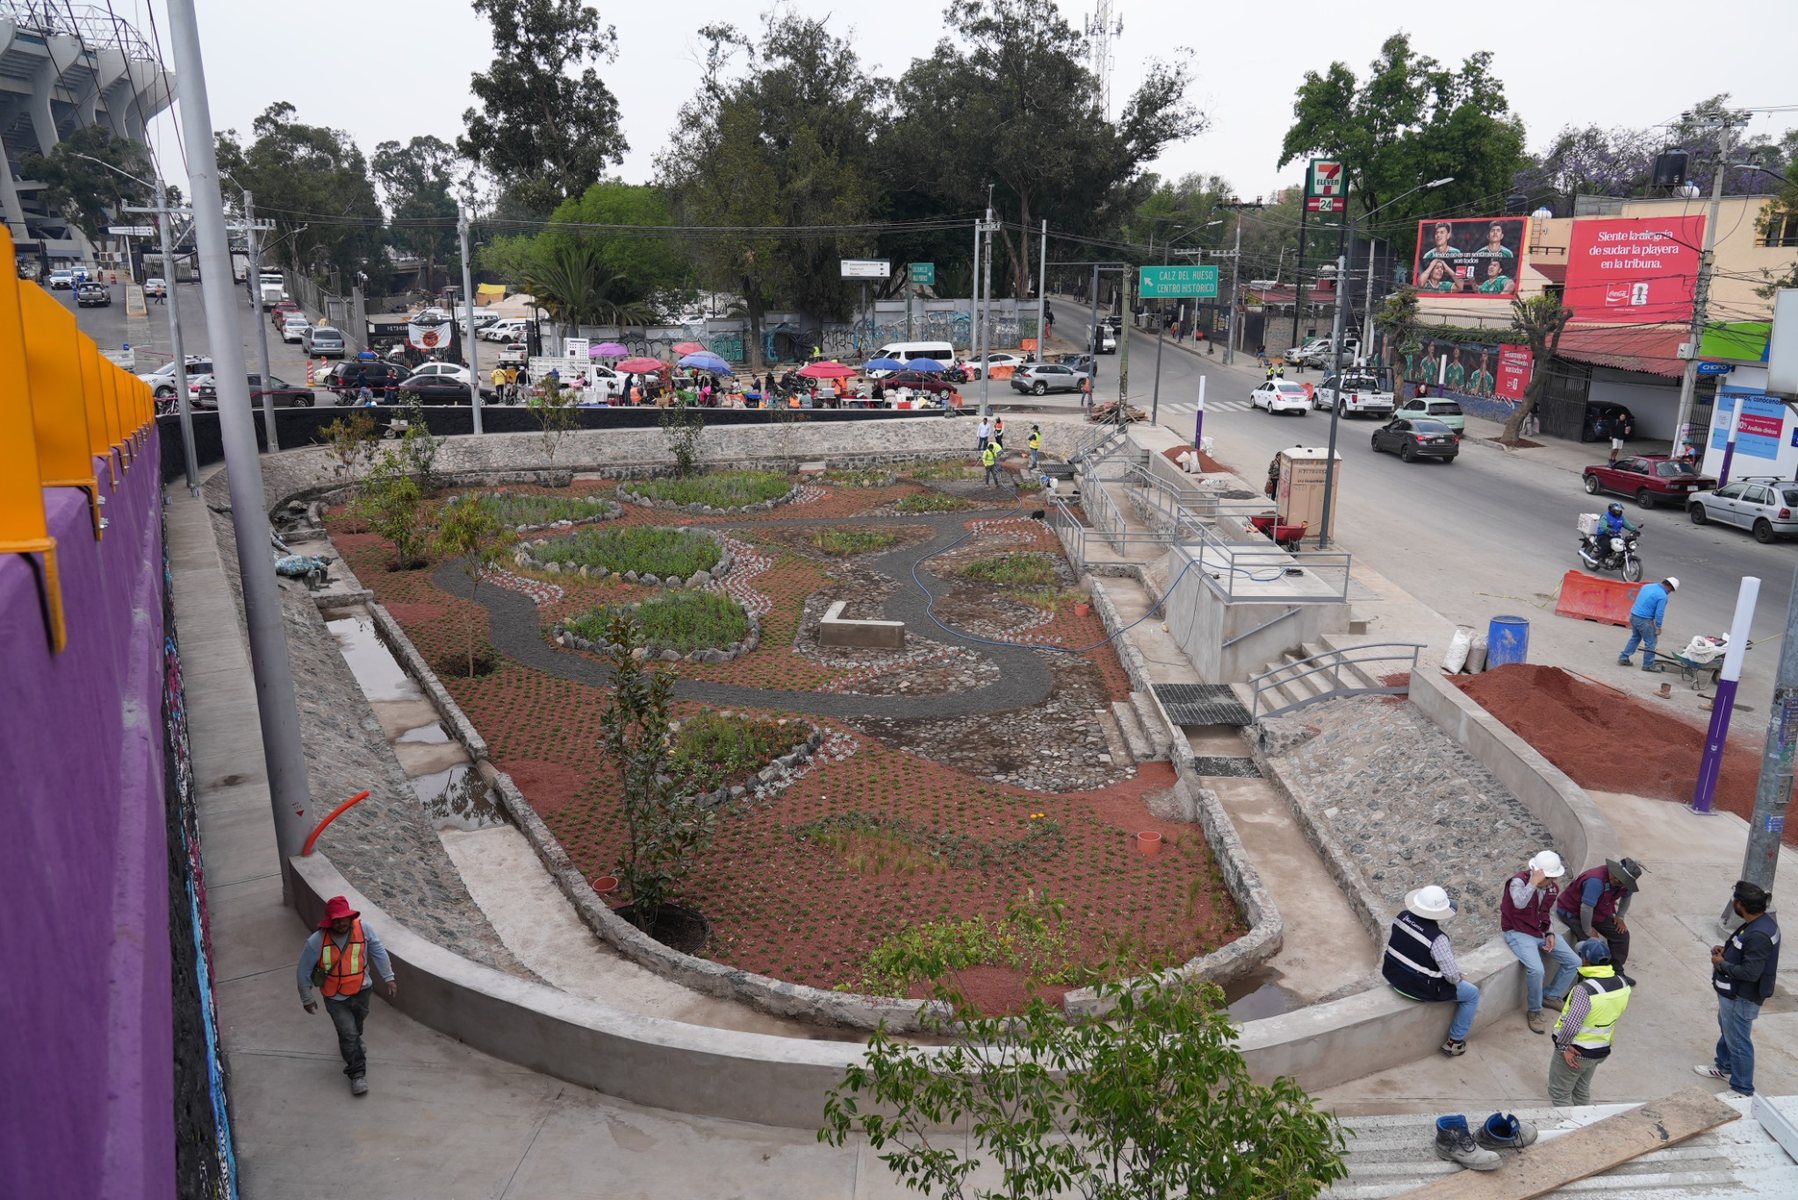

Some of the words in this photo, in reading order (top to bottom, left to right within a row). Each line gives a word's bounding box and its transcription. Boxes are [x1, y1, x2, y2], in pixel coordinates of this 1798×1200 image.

[1318, 164, 1340, 195] 7
[1320, 199, 1332, 210] 24
[1598, 231, 1628, 242] Siente
[1589, 245, 1601, 256] de
[1602, 245, 1631, 255] sudar
[1631, 244, 1640, 255] la
[1641, 243, 1679, 257] playera
[1600, 260, 1613, 269] en
[1614, 259, 1623, 269] la
[1624, 259, 1662, 269] tribuna.
[1159, 271, 1176, 280] CALZ
[1178, 271, 1188, 280] DEL
[1192, 271, 1214, 280] HUESO
[1157, 284, 1180, 293] CENTRO
